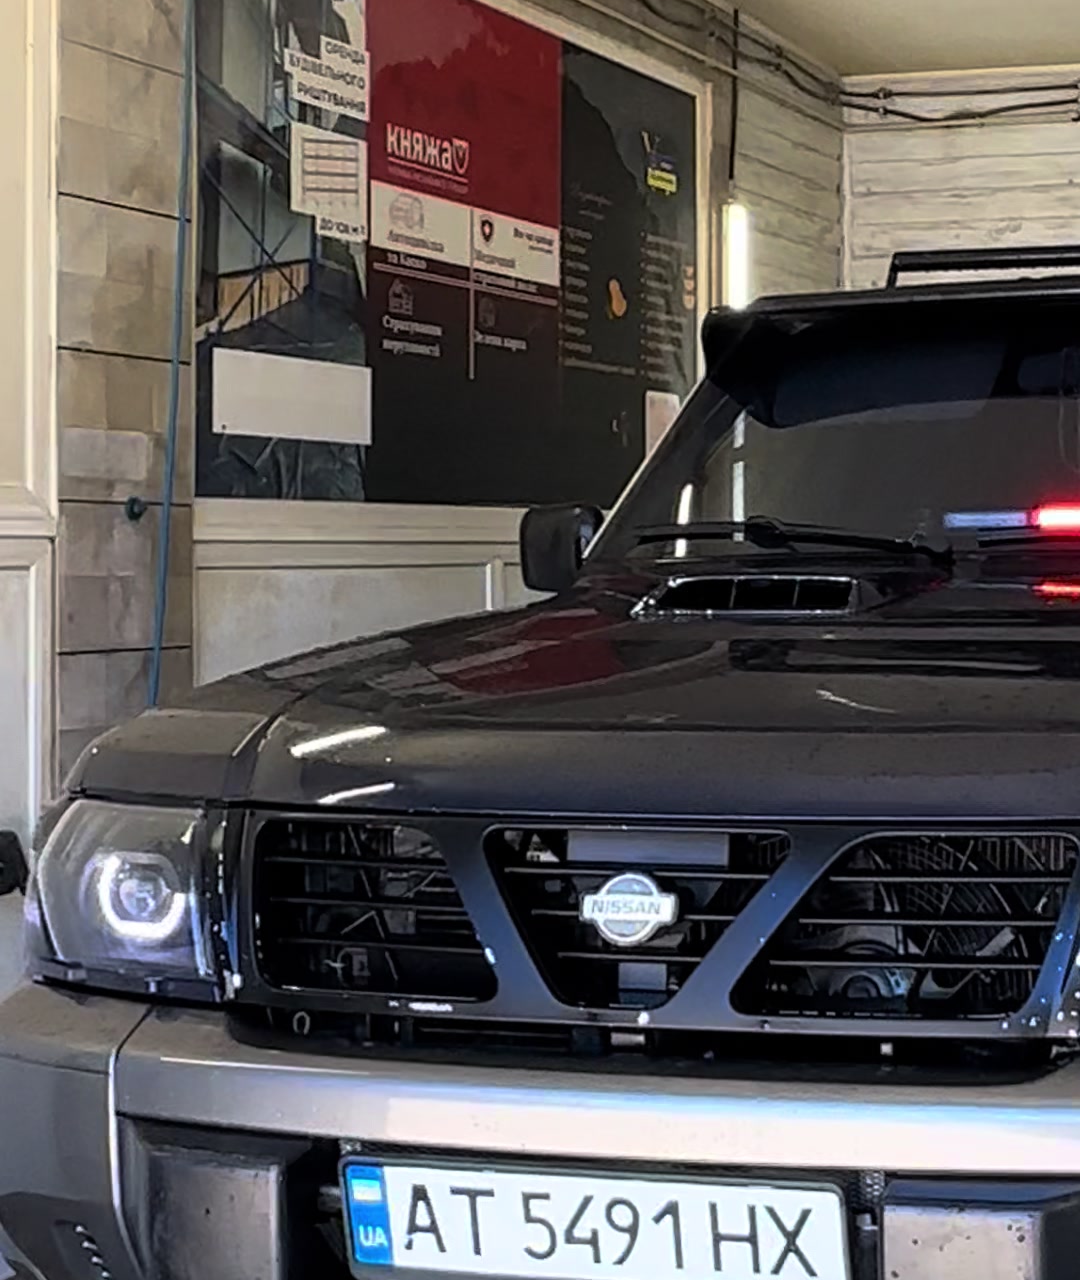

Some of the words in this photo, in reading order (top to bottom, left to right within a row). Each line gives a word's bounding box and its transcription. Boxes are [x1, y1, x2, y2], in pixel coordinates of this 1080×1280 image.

[591, 899, 661, 915] NISSAN
[359, 1225, 388, 1248] UA
[404, 1184, 495, 1256] AT
[521, 1192, 684, 1270] 5491
[709, 1201, 819, 1278] HX
